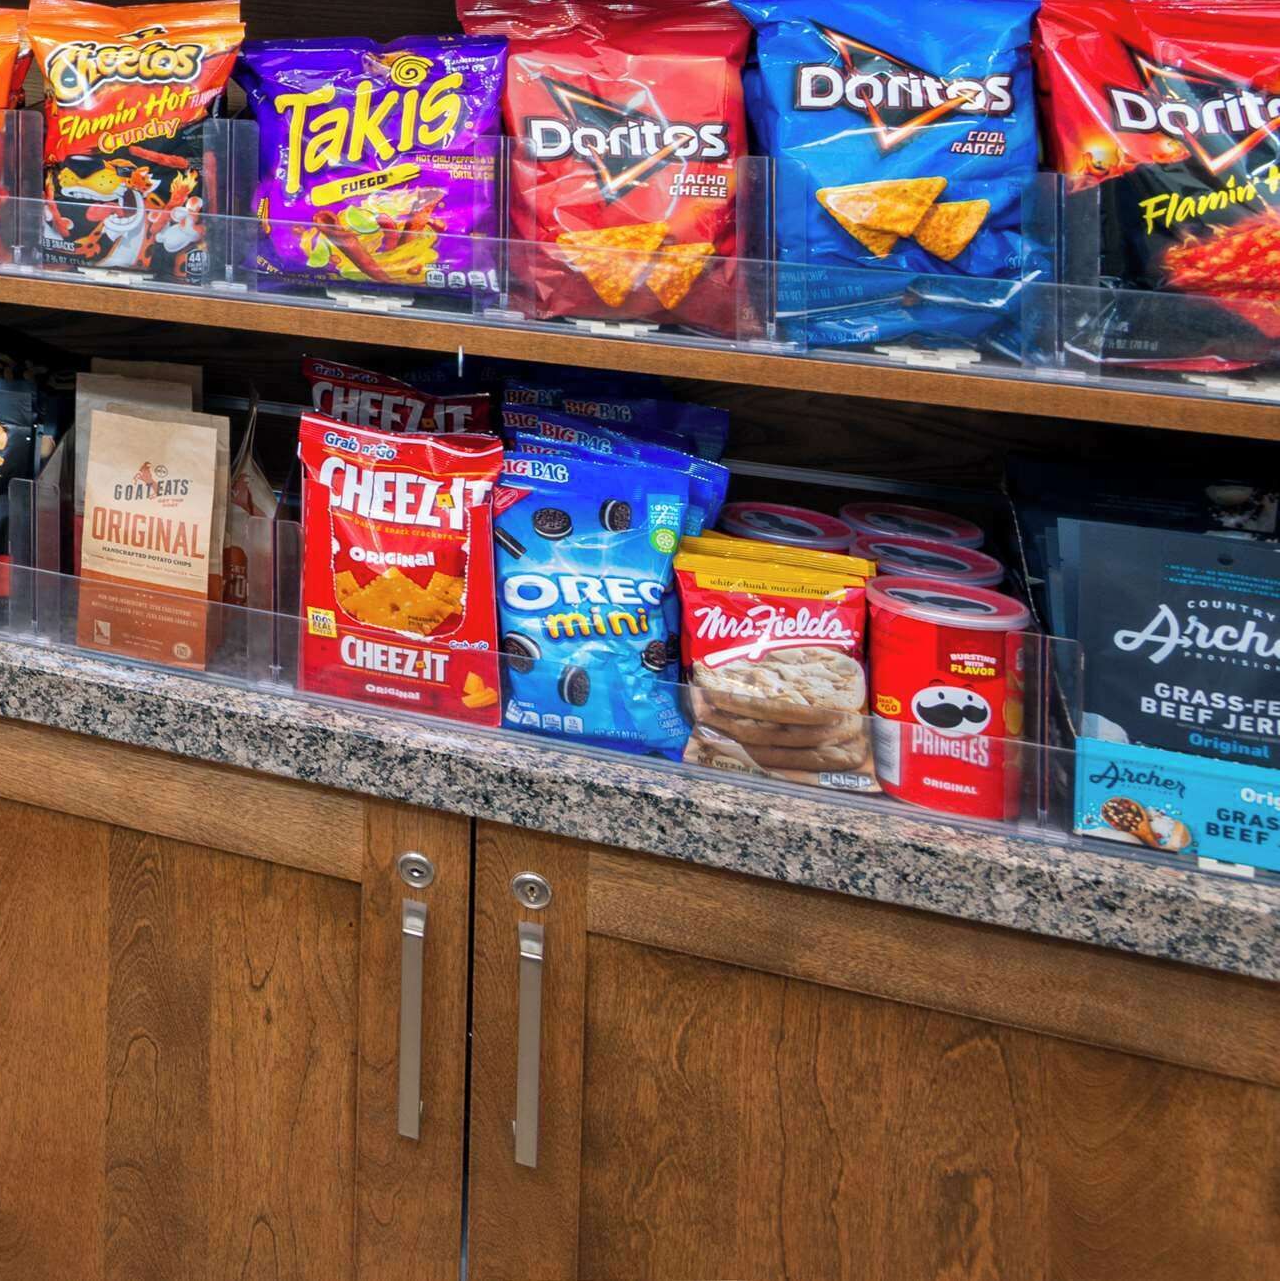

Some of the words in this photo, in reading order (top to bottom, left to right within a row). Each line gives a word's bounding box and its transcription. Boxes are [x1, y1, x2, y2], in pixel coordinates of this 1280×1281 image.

[45, 41, 204, 107] Cheetos
[796, 63, 1014, 114] Doritos
[58, 98, 142, 144] Flamin'
[144, 86, 192, 116] Hot
[97, 118, 179, 154] Crunchy
[275, 72, 463, 196] Takis
[529, 120, 729, 162] Doritos
[968, 130, 1007, 145] COOL
[951, 141, 1006, 157] RANCH
[341, 174, 388, 196] FUEGO
[669, 184, 728, 199] CHEESE
[673, 173, 727, 187] NACHO
[324, 432, 359, 451] Grab
[375, 443, 397, 460] Go
[114, 482, 153, 501] GOAT
[157, 479, 189, 497] EATS
[92, 506, 205, 559] ORIGINAL
[385, 527, 410, 536] snack
[411, 529, 453, 541] crackers
[102, 546, 147, 559] HANDCRAFTED
[148, 555, 173, 565] POTATO
[173, 559, 192, 568] CHIPS
[710, 578, 737, 587] white
[738, 580, 768, 591] chunk
[771, 584, 830, 596] macadamia
[1187, 599, 1277, 623] COUNTRY
[543, 607, 650, 641] mini
[747, 604, 852, 659] Fields
[949, 652, 997, 664] BURSTING
[950, 663, 996, 677] FLAVOR
[912, 725, 989, 768] PRINGLES
[1189, 731, 1271, 759] Original
[922, 776, 978, 794] ORIGINAL
[1089, 761, 1186, 799] Archer
[1205, 821, 1270, 846] BEEF
